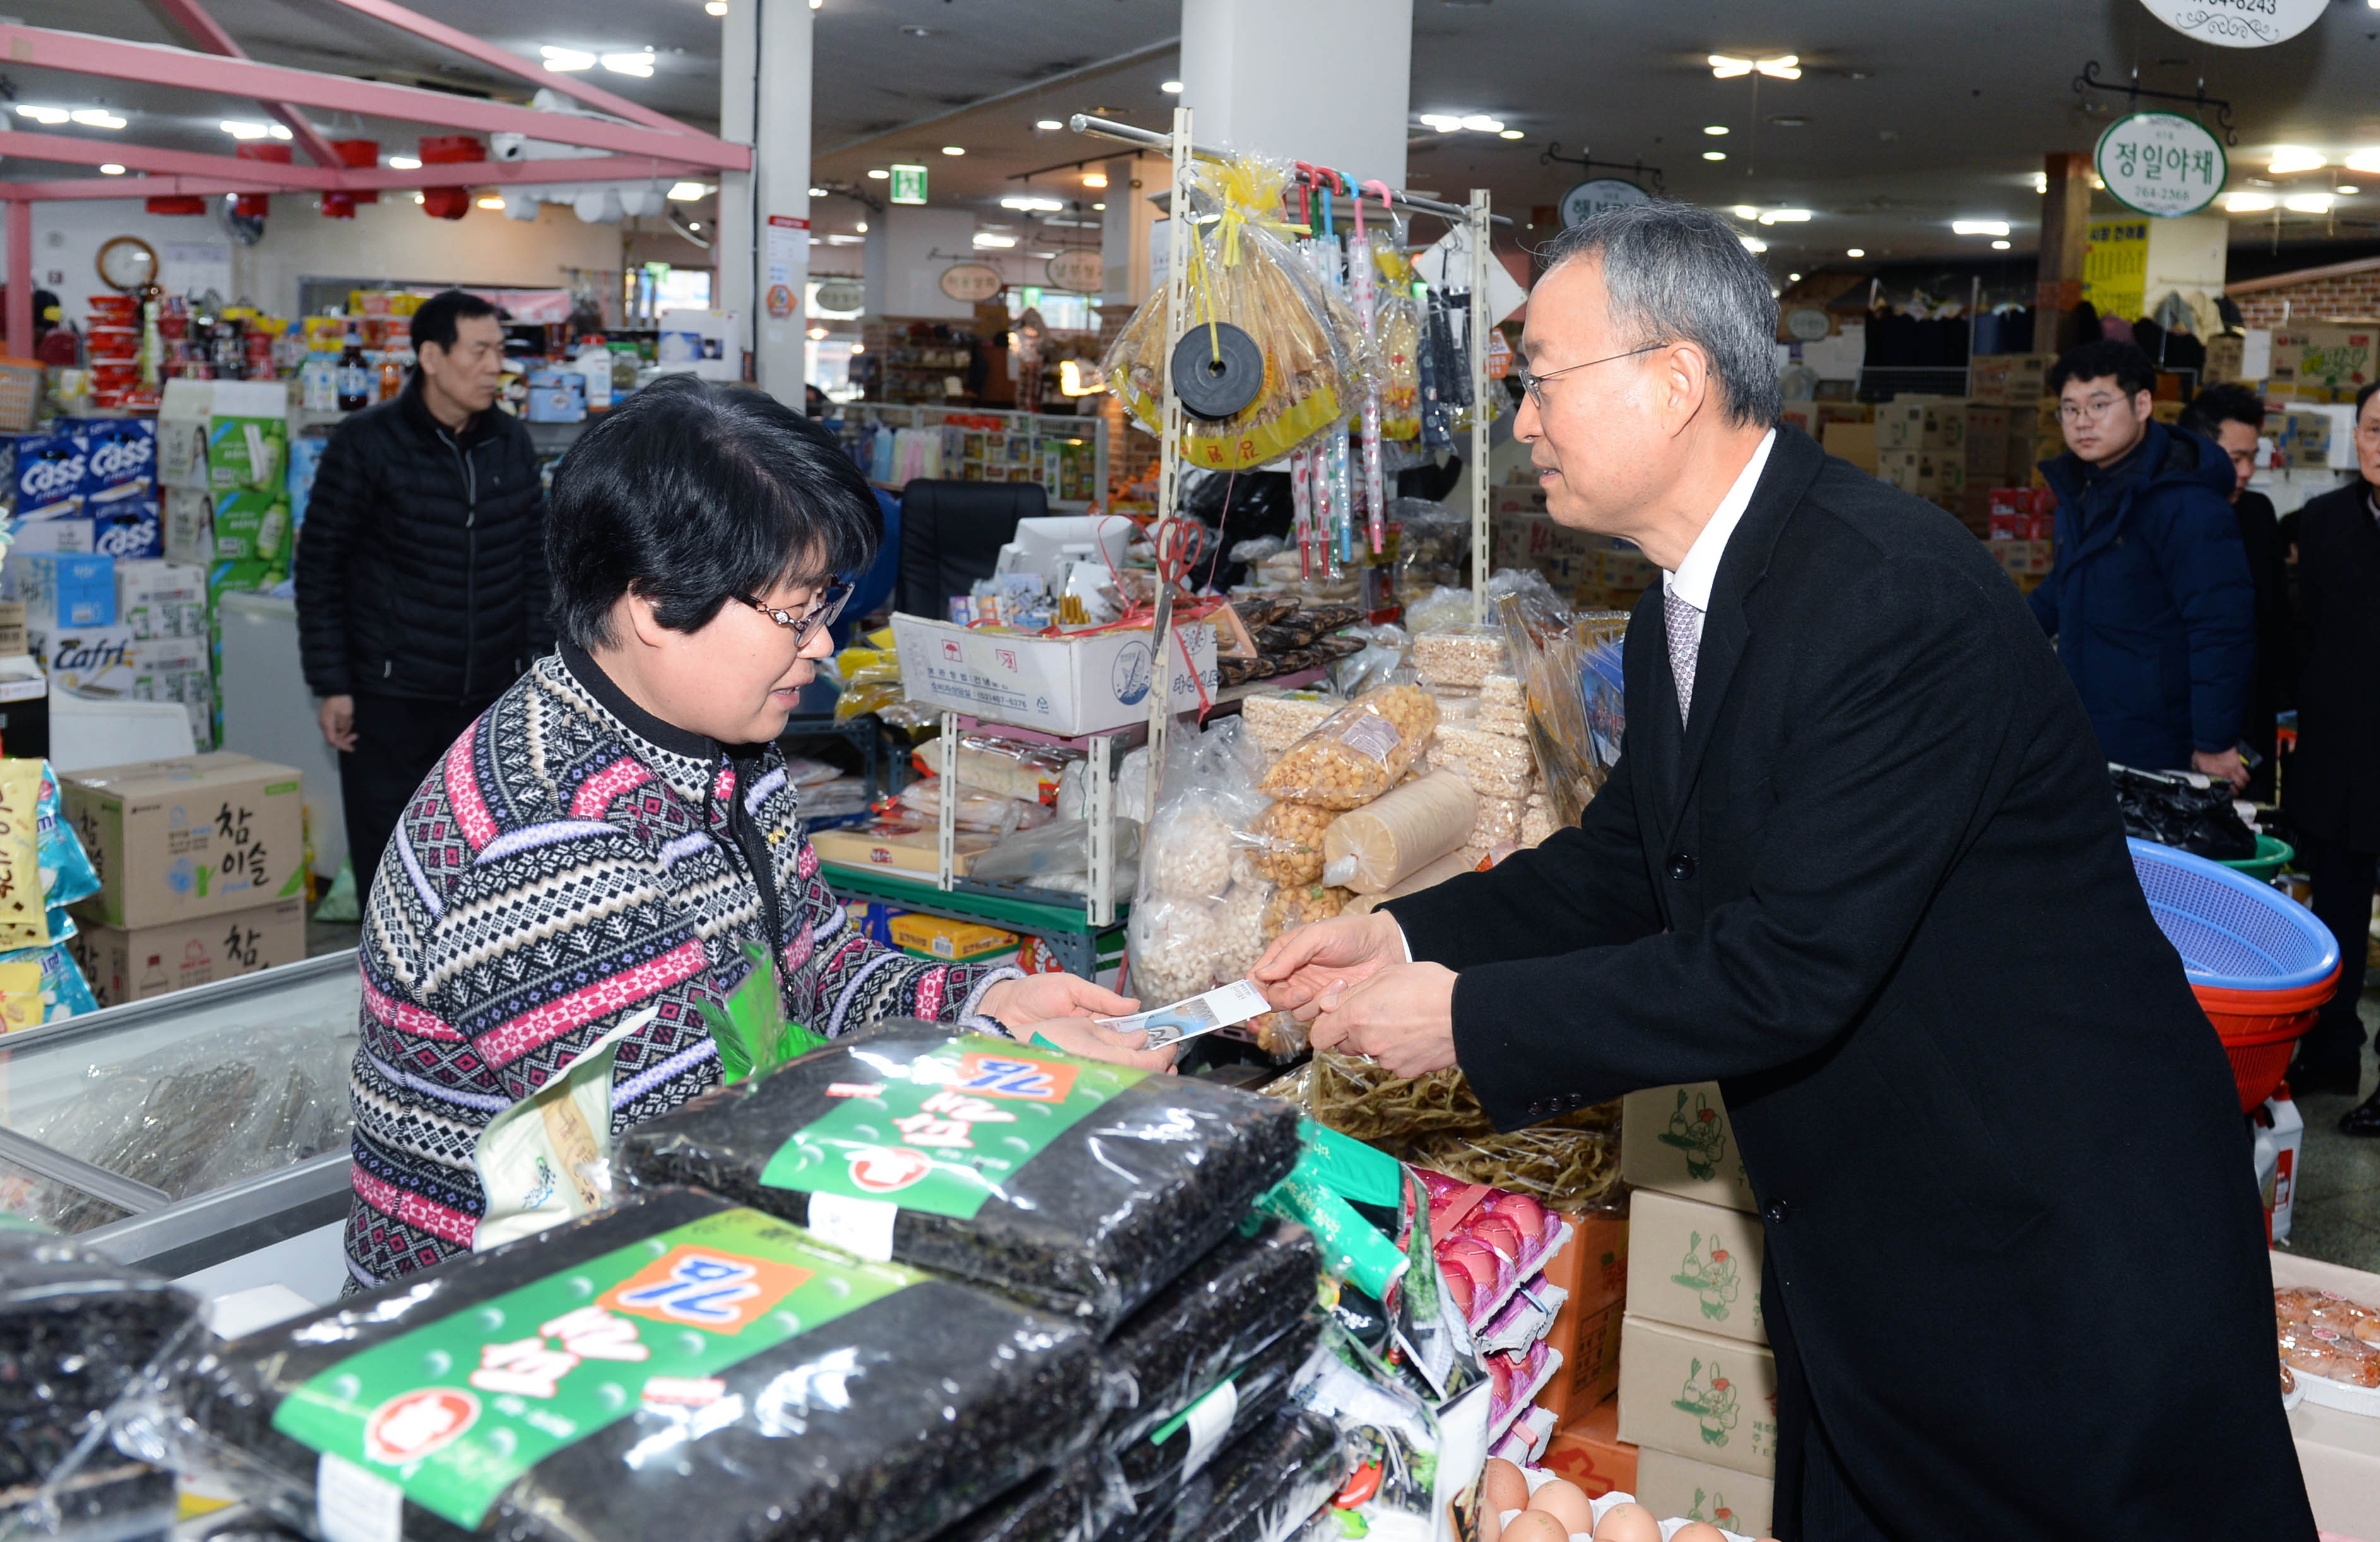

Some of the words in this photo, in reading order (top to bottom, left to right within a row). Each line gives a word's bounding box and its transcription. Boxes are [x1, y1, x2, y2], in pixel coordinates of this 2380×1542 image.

[2116, 143, 2213, 185] 정일야채
[20, 454, 86, 496] Cass
[90, 437, 152, 476] Cass
[96, 519, 156, 556] Cass
[54, 639, 129, 671] Cafri
[215, 802, 253, 846] 참
[221, 842, 270, 886] 이슬
[224, 923, 262, 967] 참
